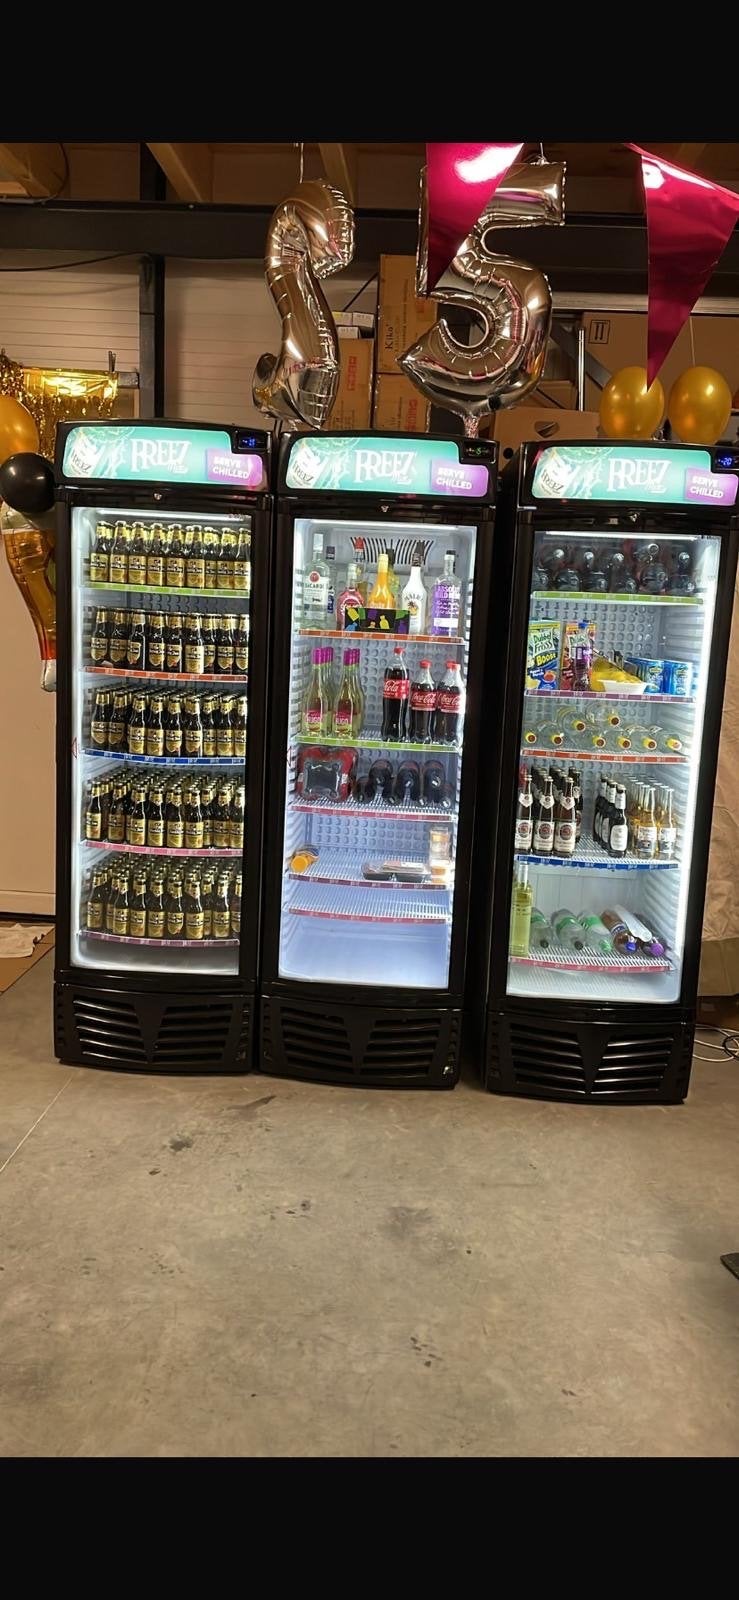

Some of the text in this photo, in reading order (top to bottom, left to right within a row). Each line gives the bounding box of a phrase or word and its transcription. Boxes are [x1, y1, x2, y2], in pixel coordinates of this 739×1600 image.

[130, 438, 192, 473] FREEZ
[214, 456, 241, 468] SERVE
[212, 466, 249, 479] CHILLED
[353, 449, 417, 483] FREEZ
[437, 467, 464, 479] SERVE
[607, 457, 672, 493] FREEZ
[436, 477, 472, 490] CHILLED
[692, 476, 718, 488] SERVE
[690, 486, 724, 498] CHILLED
